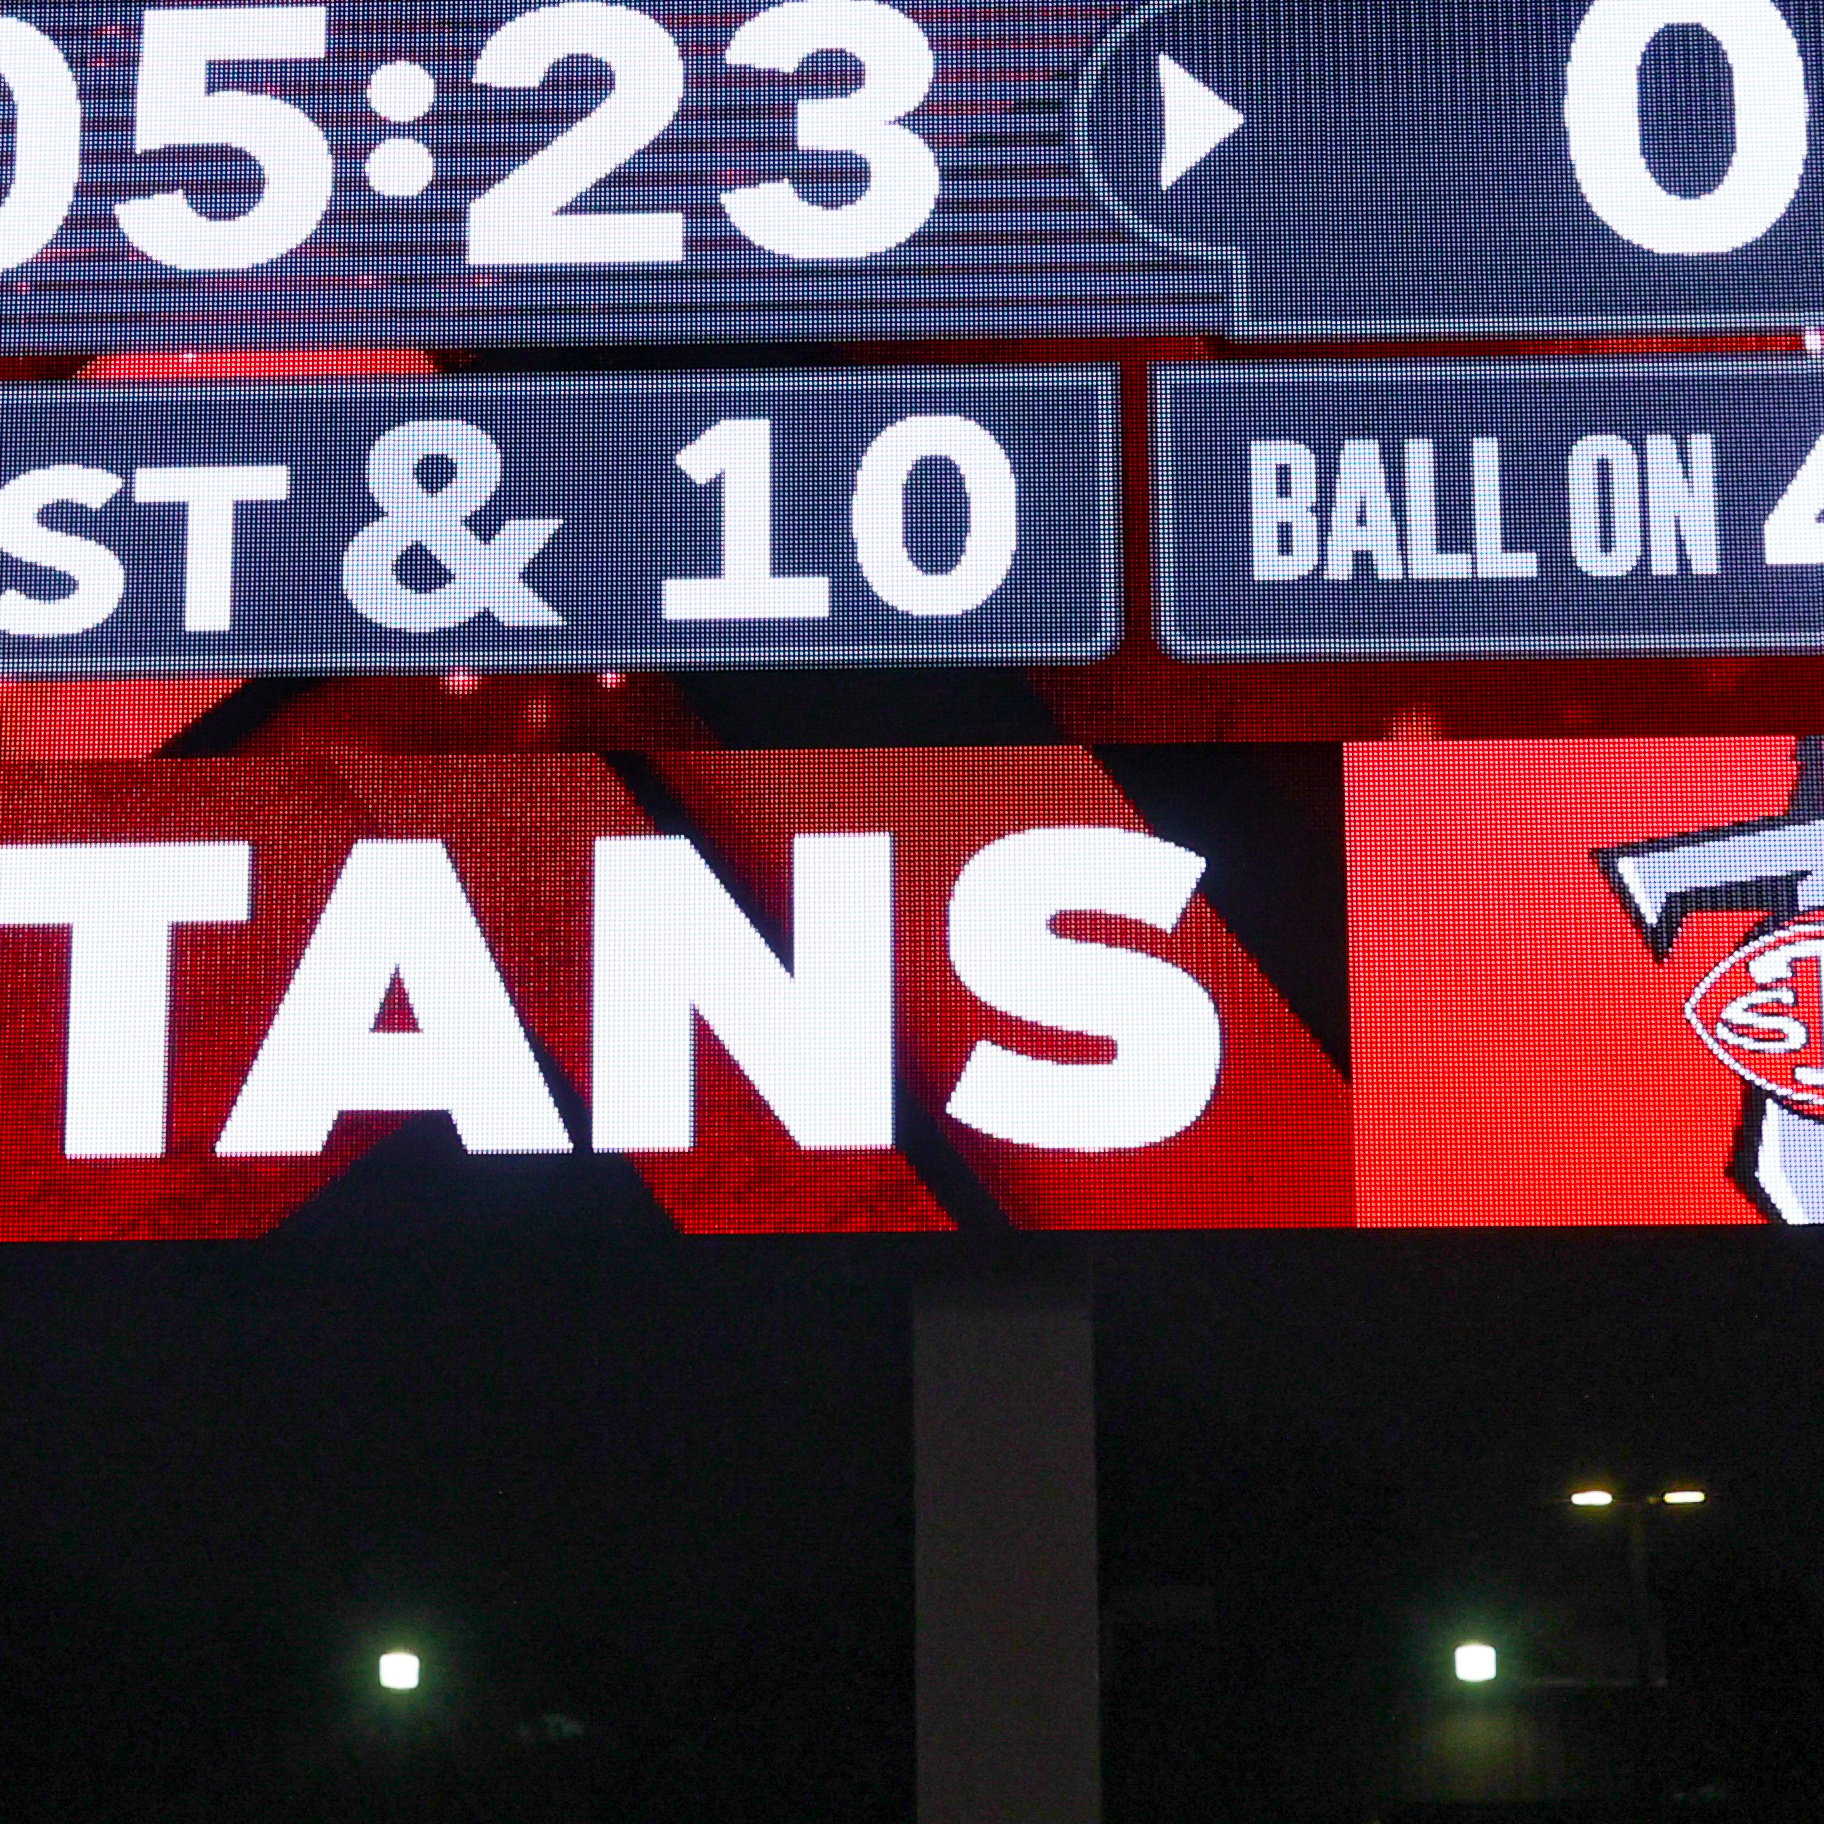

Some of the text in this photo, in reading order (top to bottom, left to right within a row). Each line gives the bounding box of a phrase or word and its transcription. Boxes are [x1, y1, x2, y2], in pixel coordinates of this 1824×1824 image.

[340, 417, 568, 636] &
[660, 412, 1021, 623] 10
[1249, 437, 1539, 582] BALL
[1567, 432, 1721, 580] ON
